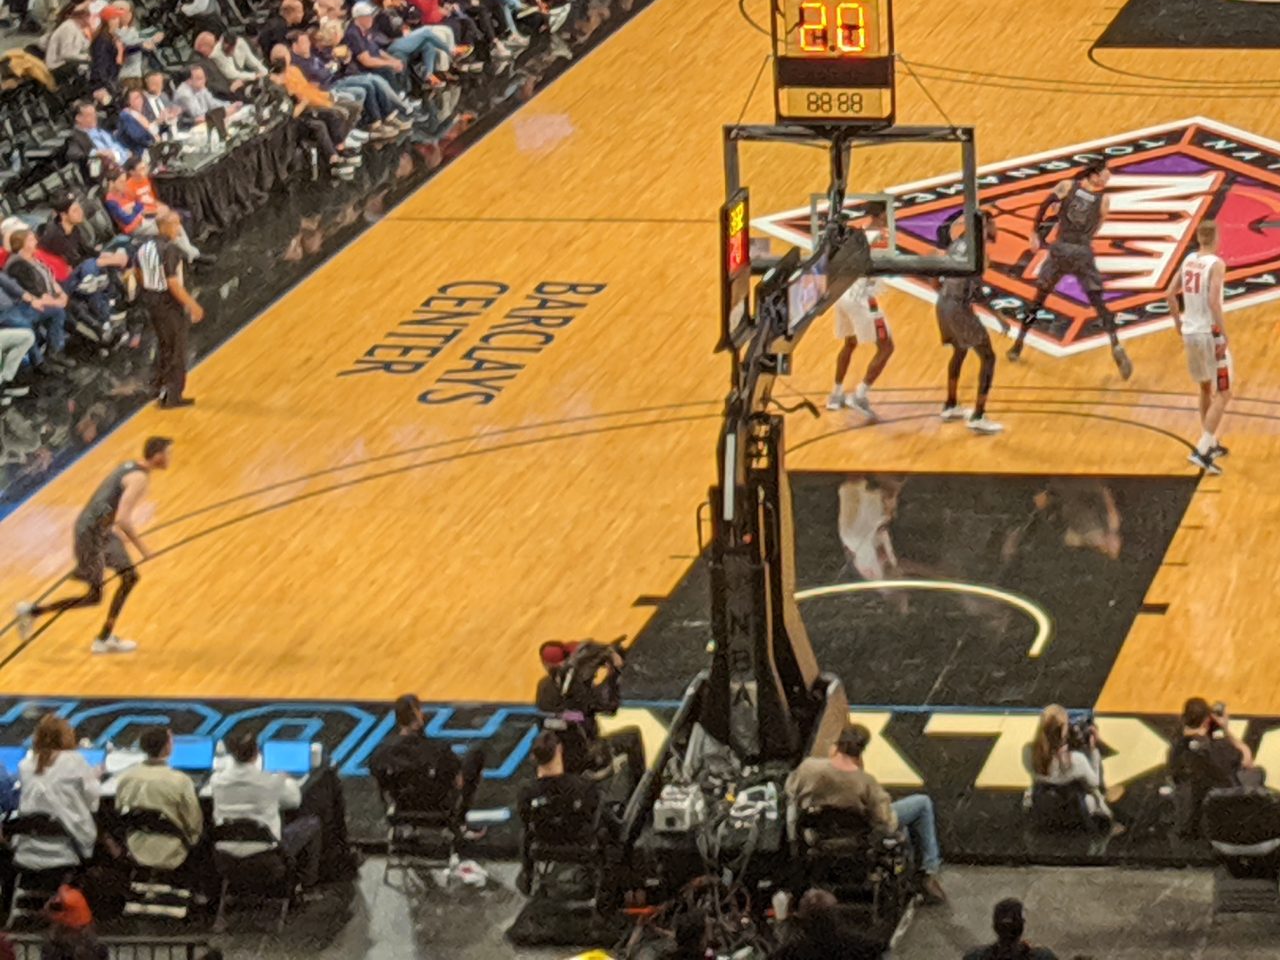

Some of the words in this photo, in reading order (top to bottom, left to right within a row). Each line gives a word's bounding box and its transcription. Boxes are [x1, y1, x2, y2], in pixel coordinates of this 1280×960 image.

[800, 3, 865, 51] 20
[1184, 270, 1201, 294] 21
[335, 280, 511, 378] CENTER
[417, 280, 608, 406] BARCLAYS
